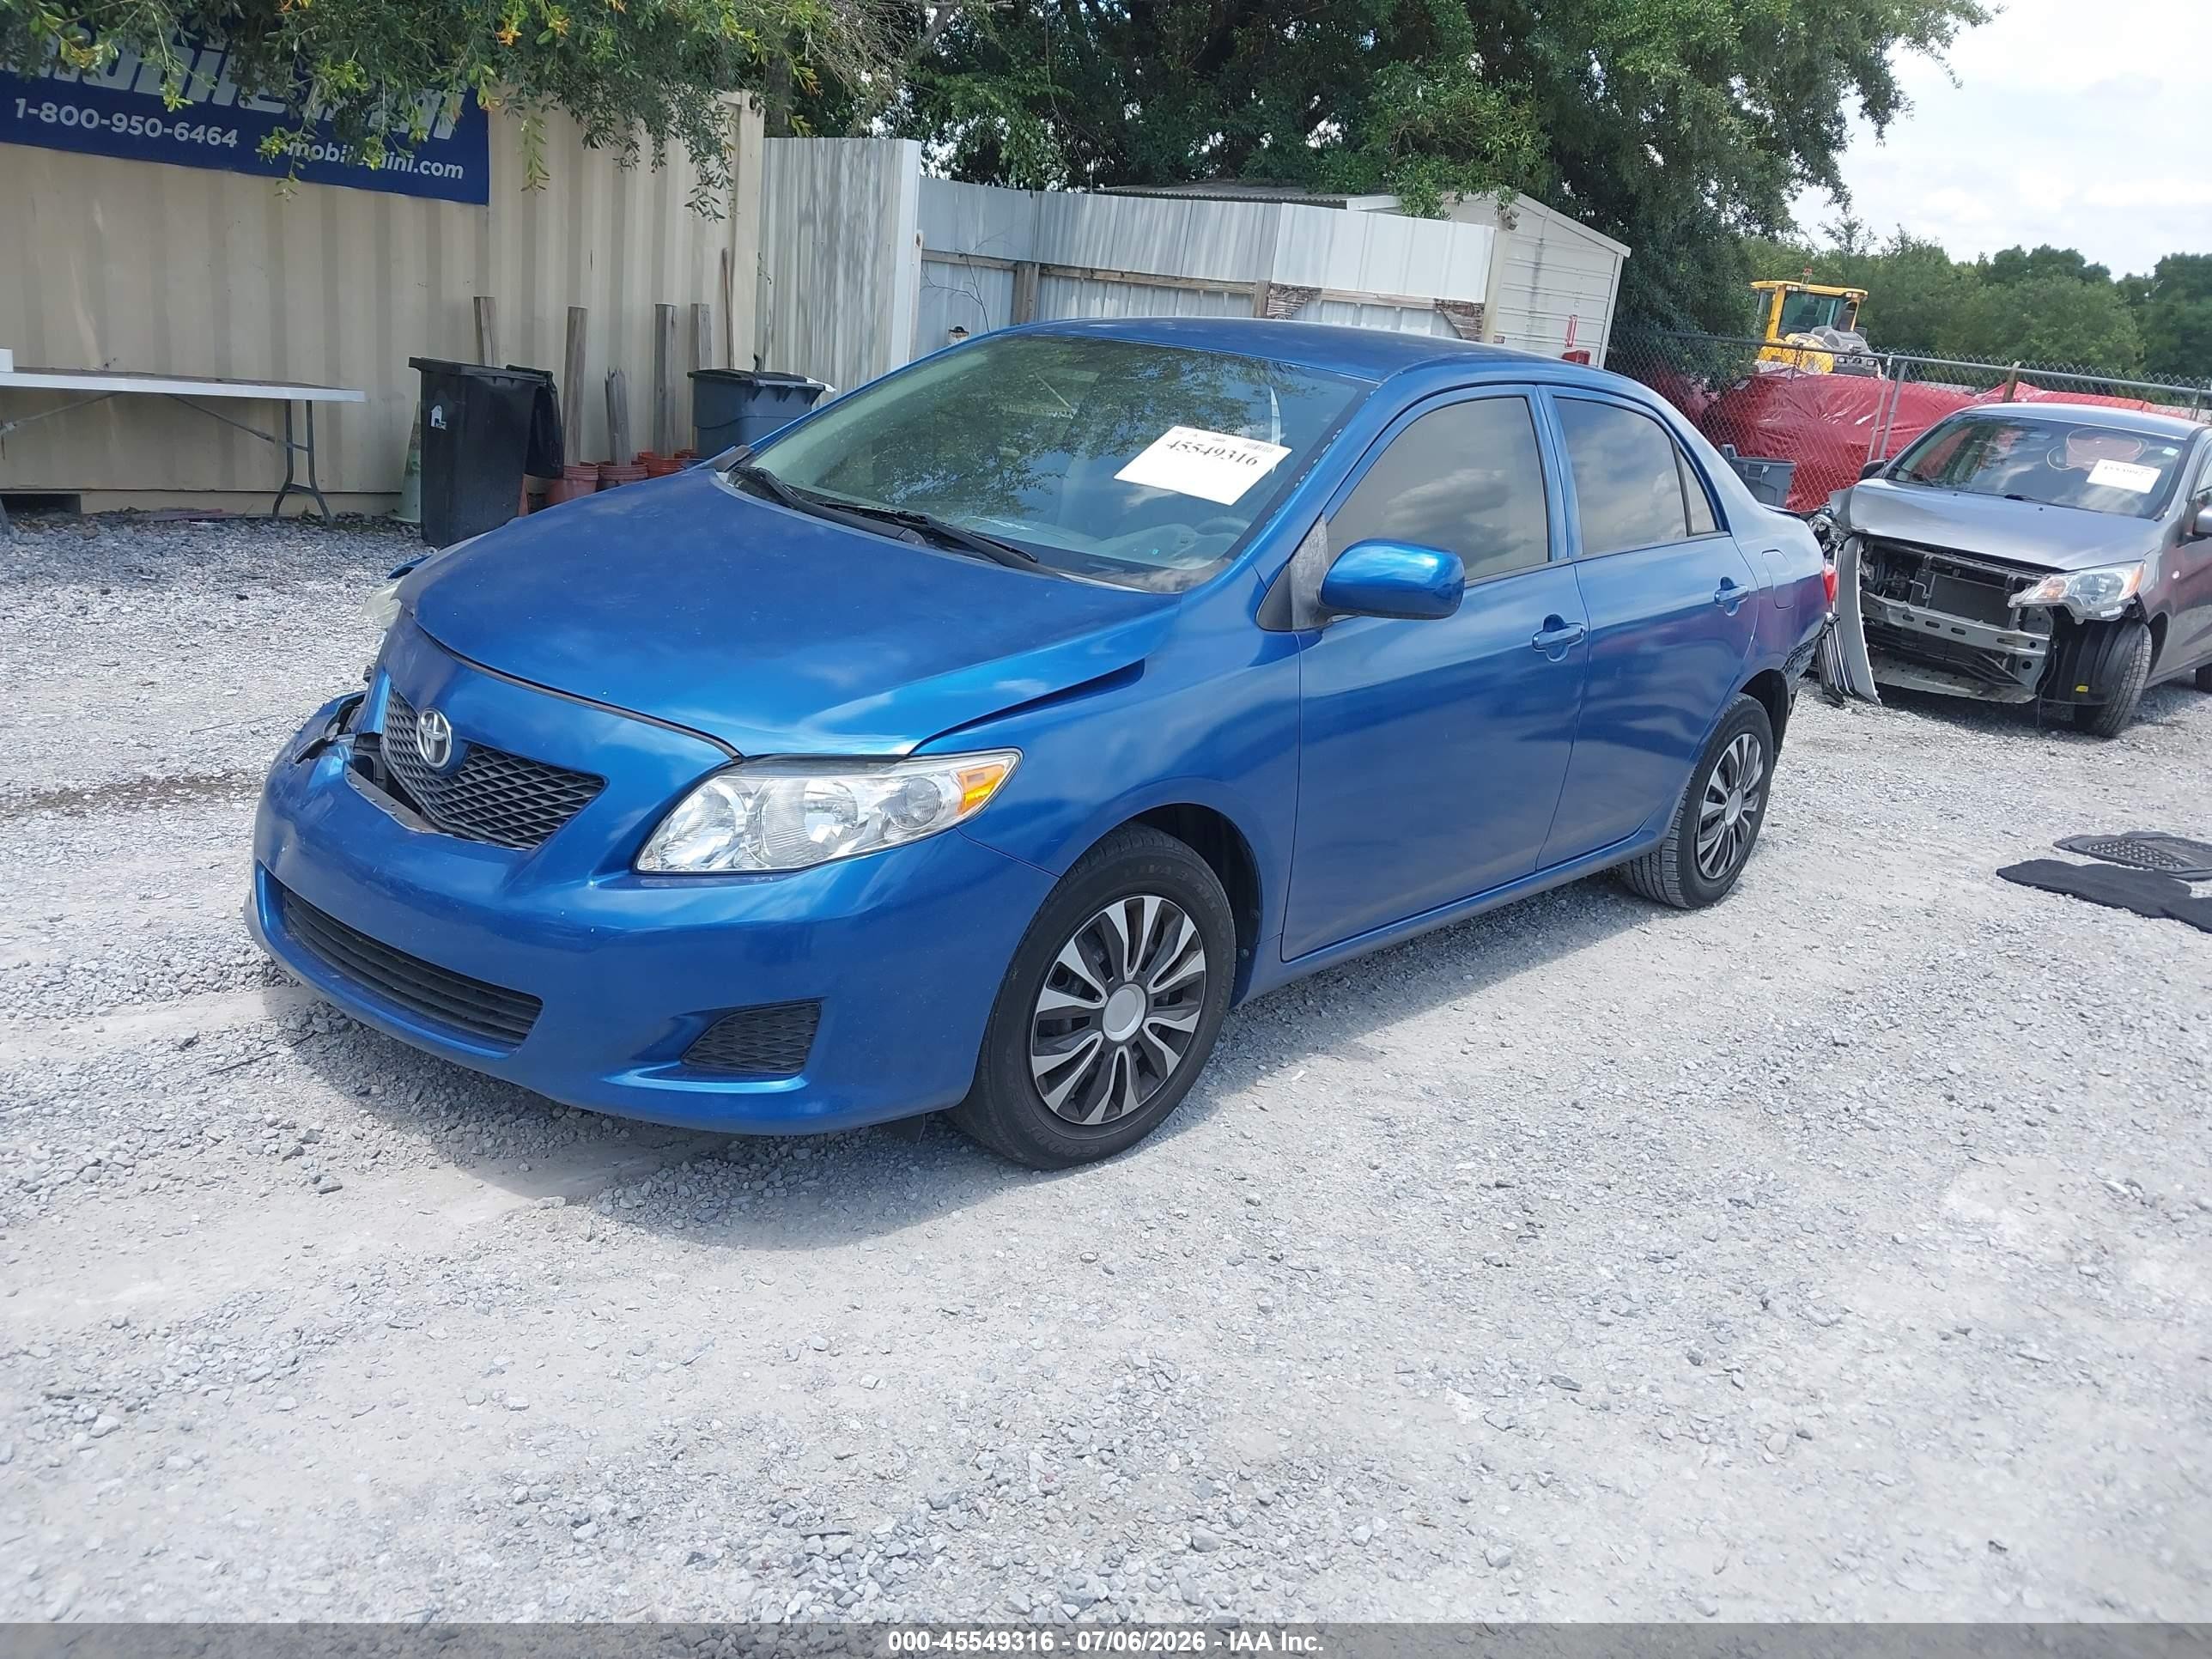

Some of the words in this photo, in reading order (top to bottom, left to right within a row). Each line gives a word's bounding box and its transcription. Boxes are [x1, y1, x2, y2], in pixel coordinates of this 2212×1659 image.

[15, 98, 239, 149] 1-800-950-6464
[288, 141, 464, 179] mobiini.com
[1166, 439, 1259, 466] 45549316
